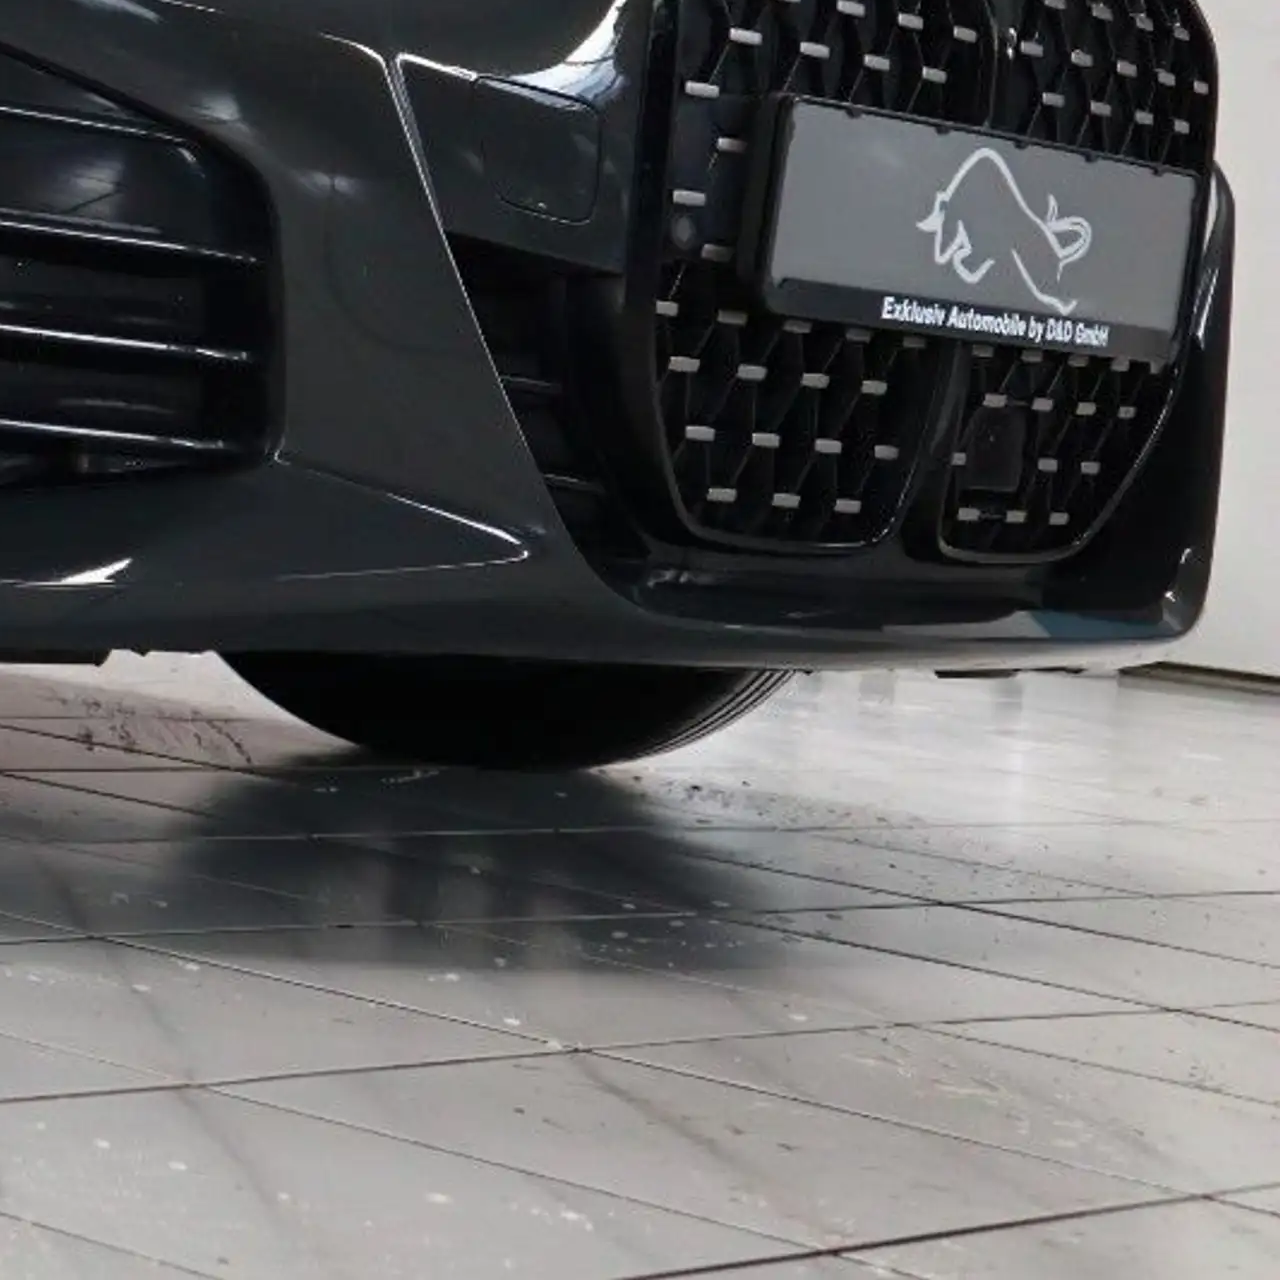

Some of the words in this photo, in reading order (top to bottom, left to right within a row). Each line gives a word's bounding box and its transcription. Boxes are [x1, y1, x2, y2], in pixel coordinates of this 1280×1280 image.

[881, 296, 946, 326] Exklusiv
[947, 305, 1027, 336] Automobile
[1027, 316, 1044, 343] by
[1075, 323, 1110, 347] GmbH
